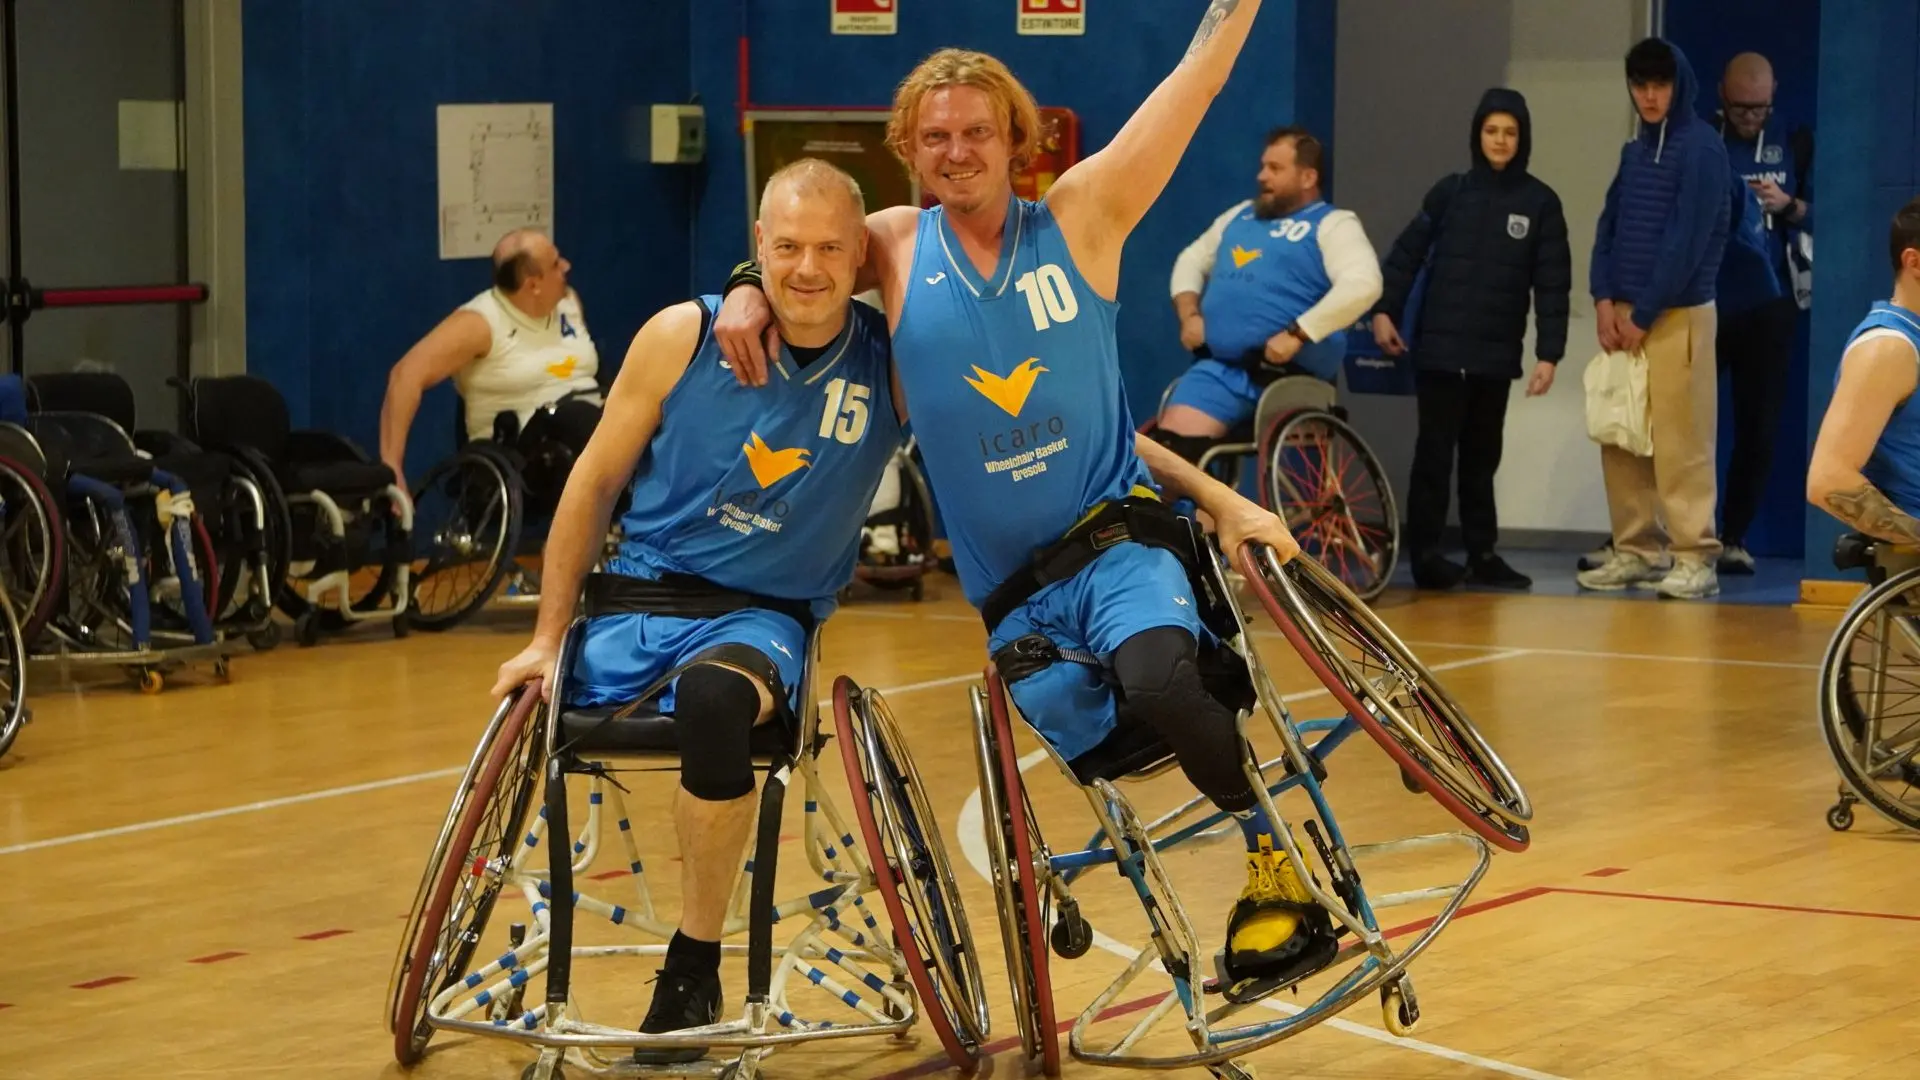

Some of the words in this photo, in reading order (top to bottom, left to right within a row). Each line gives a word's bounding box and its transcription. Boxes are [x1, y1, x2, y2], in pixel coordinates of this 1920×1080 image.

[1021, 18, 1080, 29] ESTINTORE
[1269, 218, 1312, 243] 30
[1014, 263, 1079, 331] 10
[560, 312, 577, 339] 4
[818, 377, 871, 445] 15
[978, 416, 1064, 456] icaro
[984, 451, 1036, 474] Wheelchair
[1034, 437, 1069, 459] Basket
